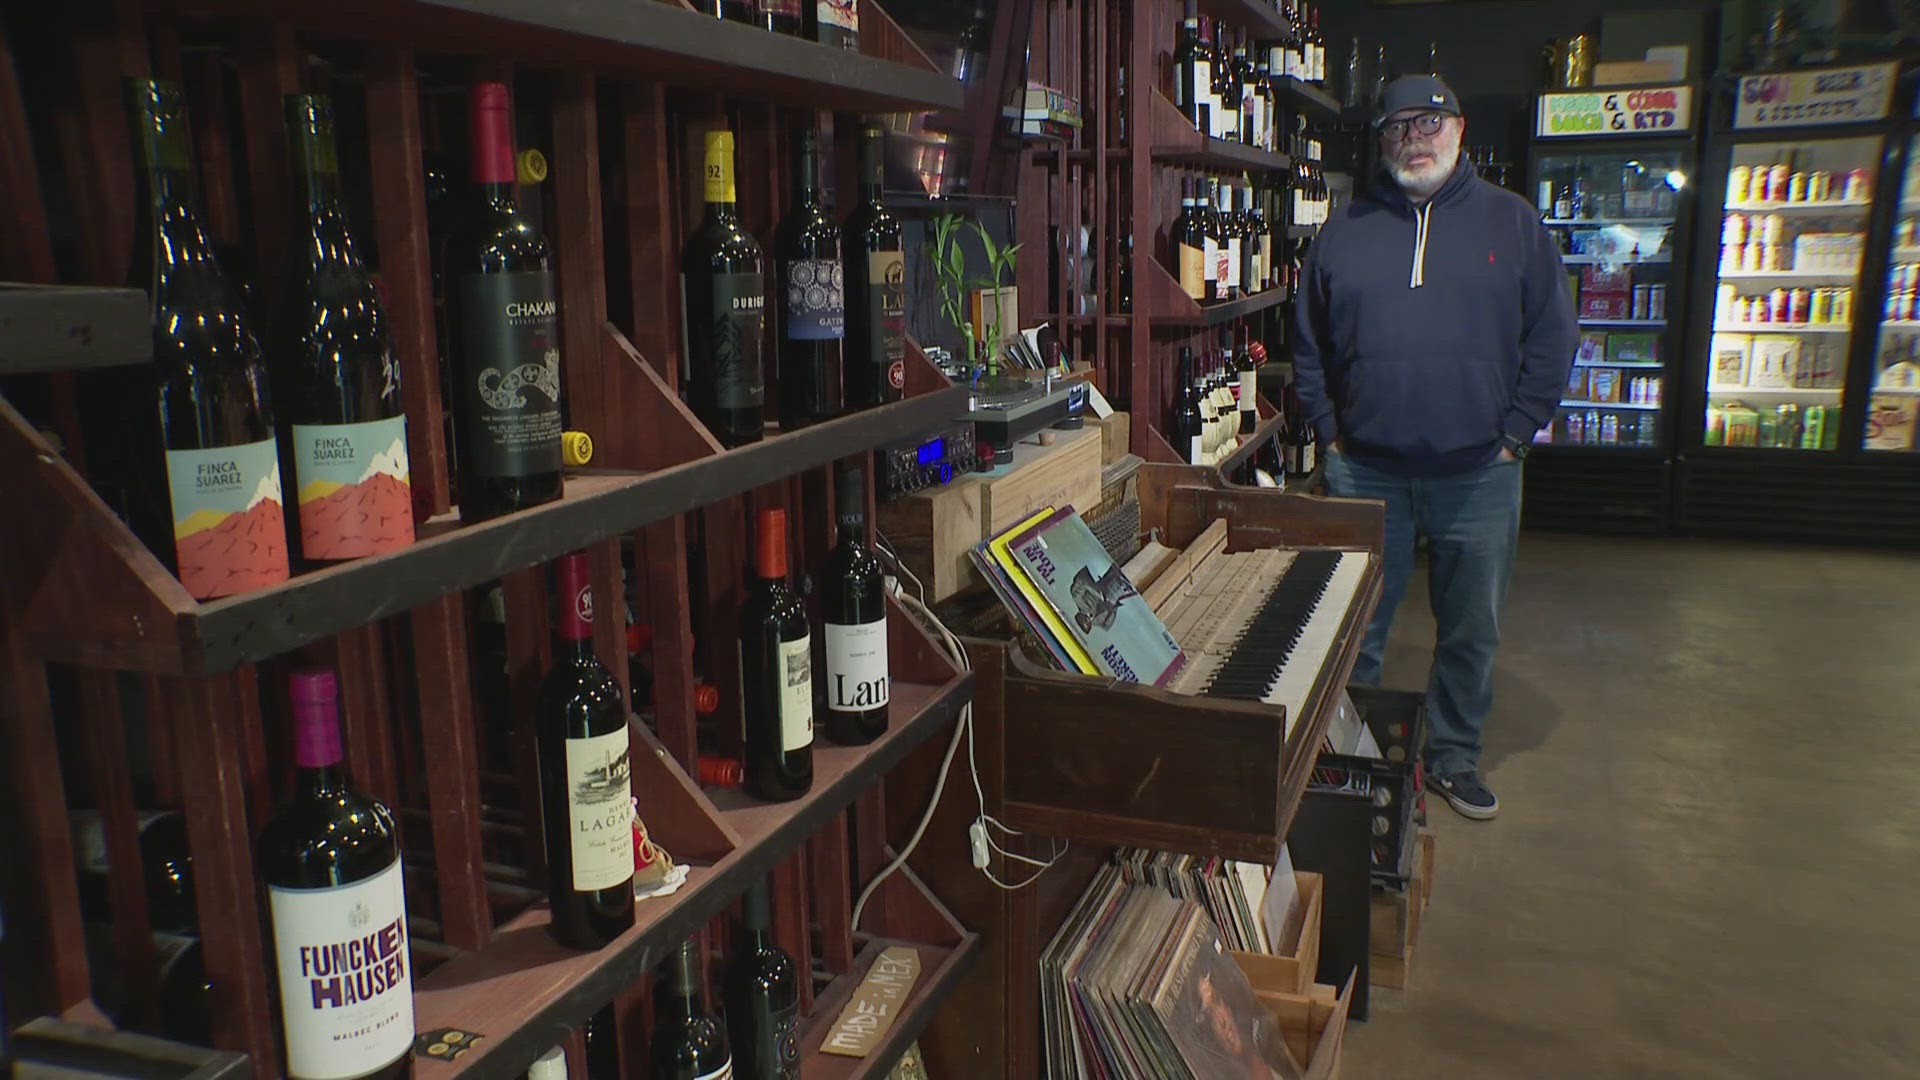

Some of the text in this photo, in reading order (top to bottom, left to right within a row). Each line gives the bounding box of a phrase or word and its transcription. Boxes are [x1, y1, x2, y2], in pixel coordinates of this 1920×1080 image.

[708, 164, 721, 178] 92
[315, 437, 350, 449] FINCA
[313, 447, 355, 460] SUAREZ
[198, 461, 238, 475] FINCA
[196, 472, 242, 488] SUAREZ
[1023, 546, 1039, 564] IN
[1031, 541, 1056, 575] LOVE
[1107, 643, 1141, 683] ICKETT
[834, 673, 887, 708] Lan
[300, 914, 405, 977] FUNCKEN
[311, 949, 405, 1010] HAUSEN
[830, 999, 888, 1049] MADE
[868, 953, 913, 987] MEX
[333, 1026, 373, 1042] MALBEC
